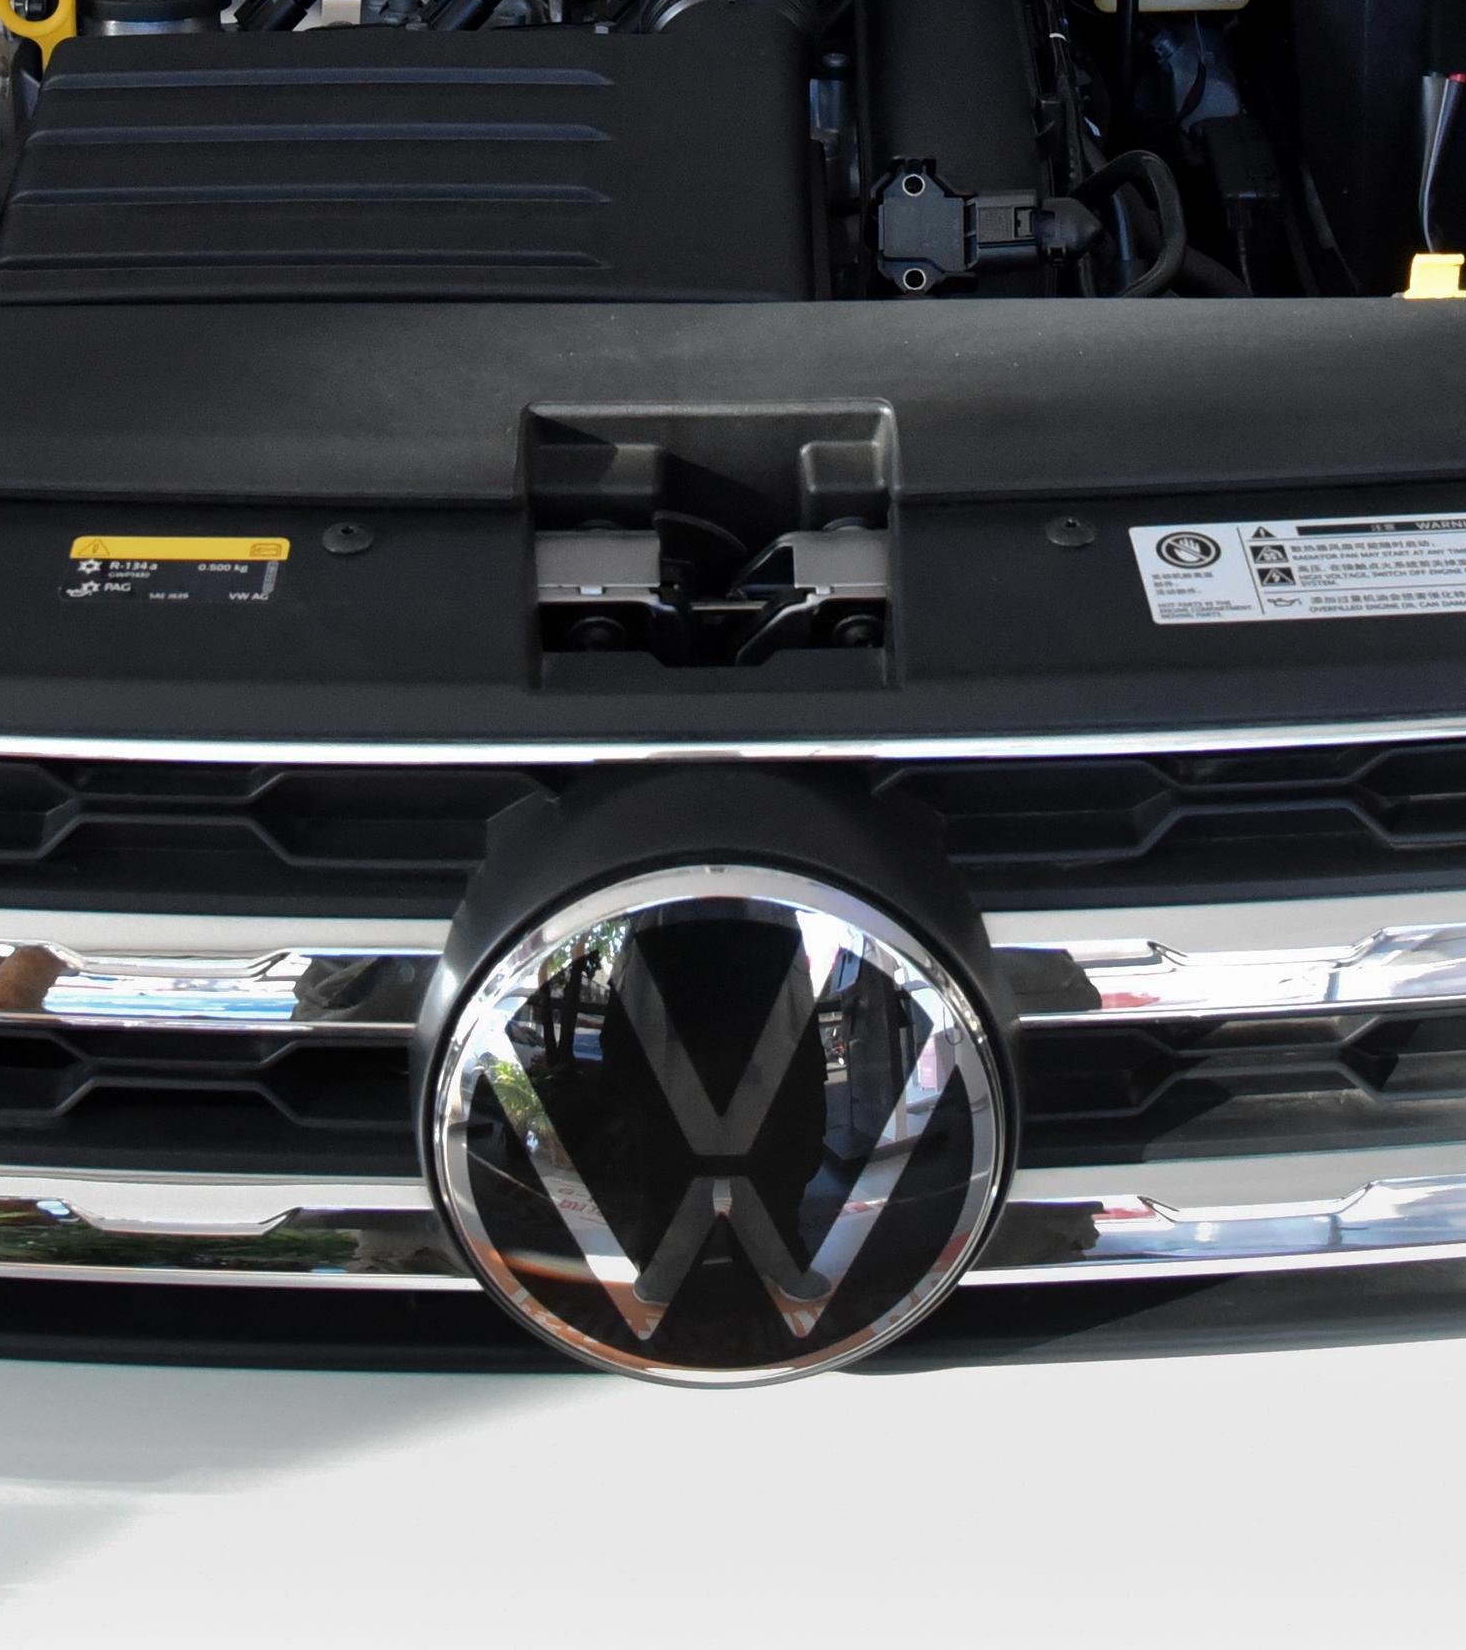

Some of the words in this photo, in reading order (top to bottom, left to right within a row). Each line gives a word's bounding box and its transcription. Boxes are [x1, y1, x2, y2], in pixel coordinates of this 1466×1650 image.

[233, 563, 249, 574] kg
[103, 582, 132, 592] PAG
[228, 592, 250, 601] VW
[251, 592, 270, 601] AG
